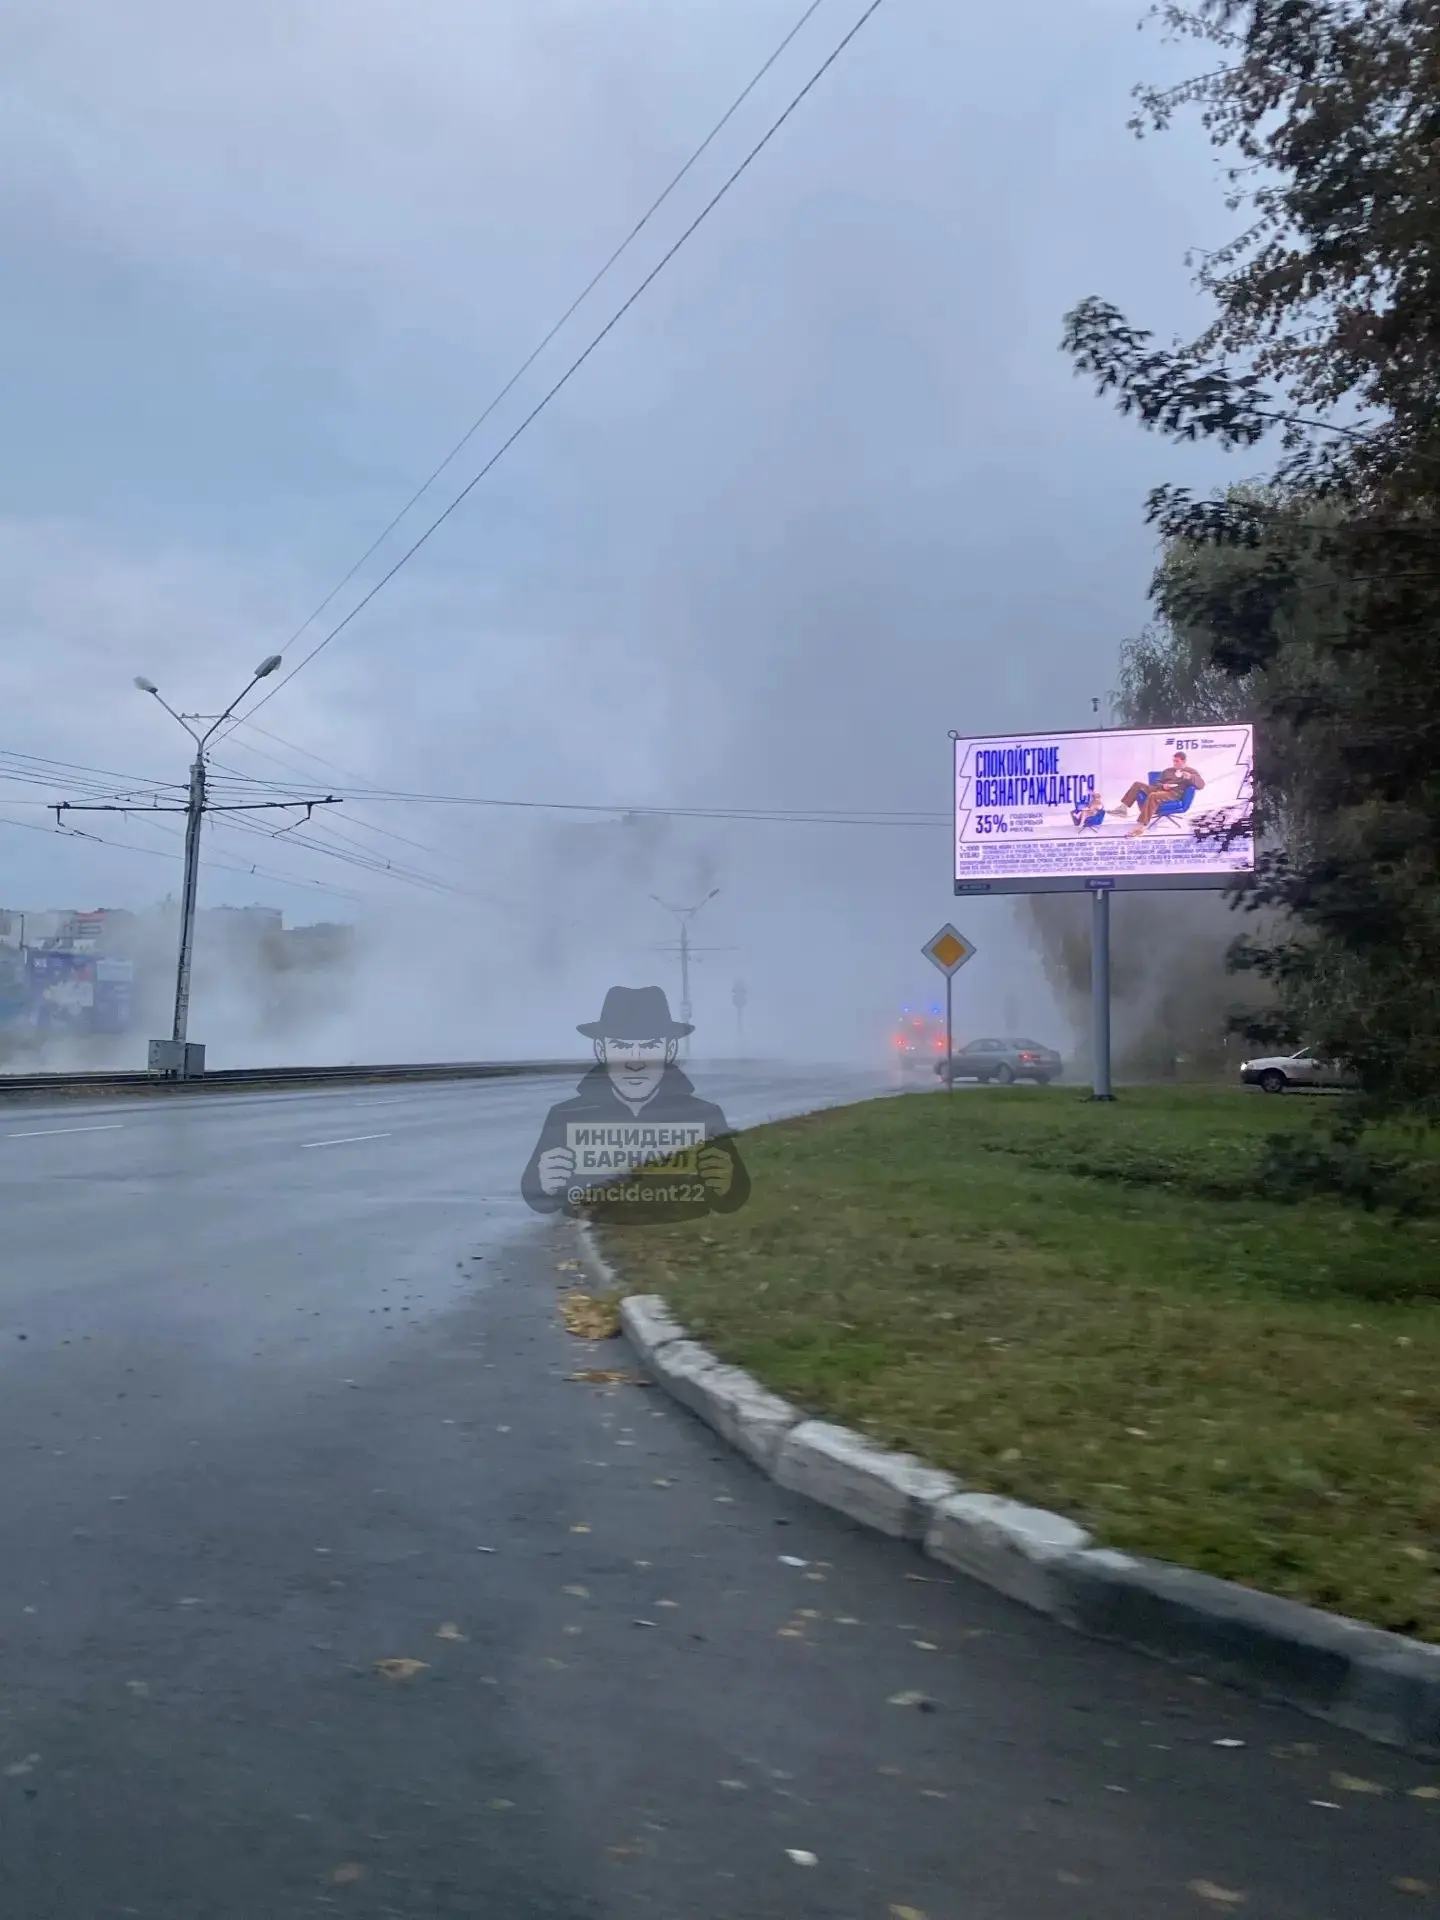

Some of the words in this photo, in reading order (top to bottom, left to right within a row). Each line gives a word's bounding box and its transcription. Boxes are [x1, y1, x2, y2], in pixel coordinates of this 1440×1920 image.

[1176, 739, 1199, 750] ВТБ
[975, 745, 1060, 778] СПОКОЙСТВИЕ
[975, 774, 1095, 808] ВОЗНАГРАЖДАЕТСЯ
[975, 814, 1008, 834] 35%
